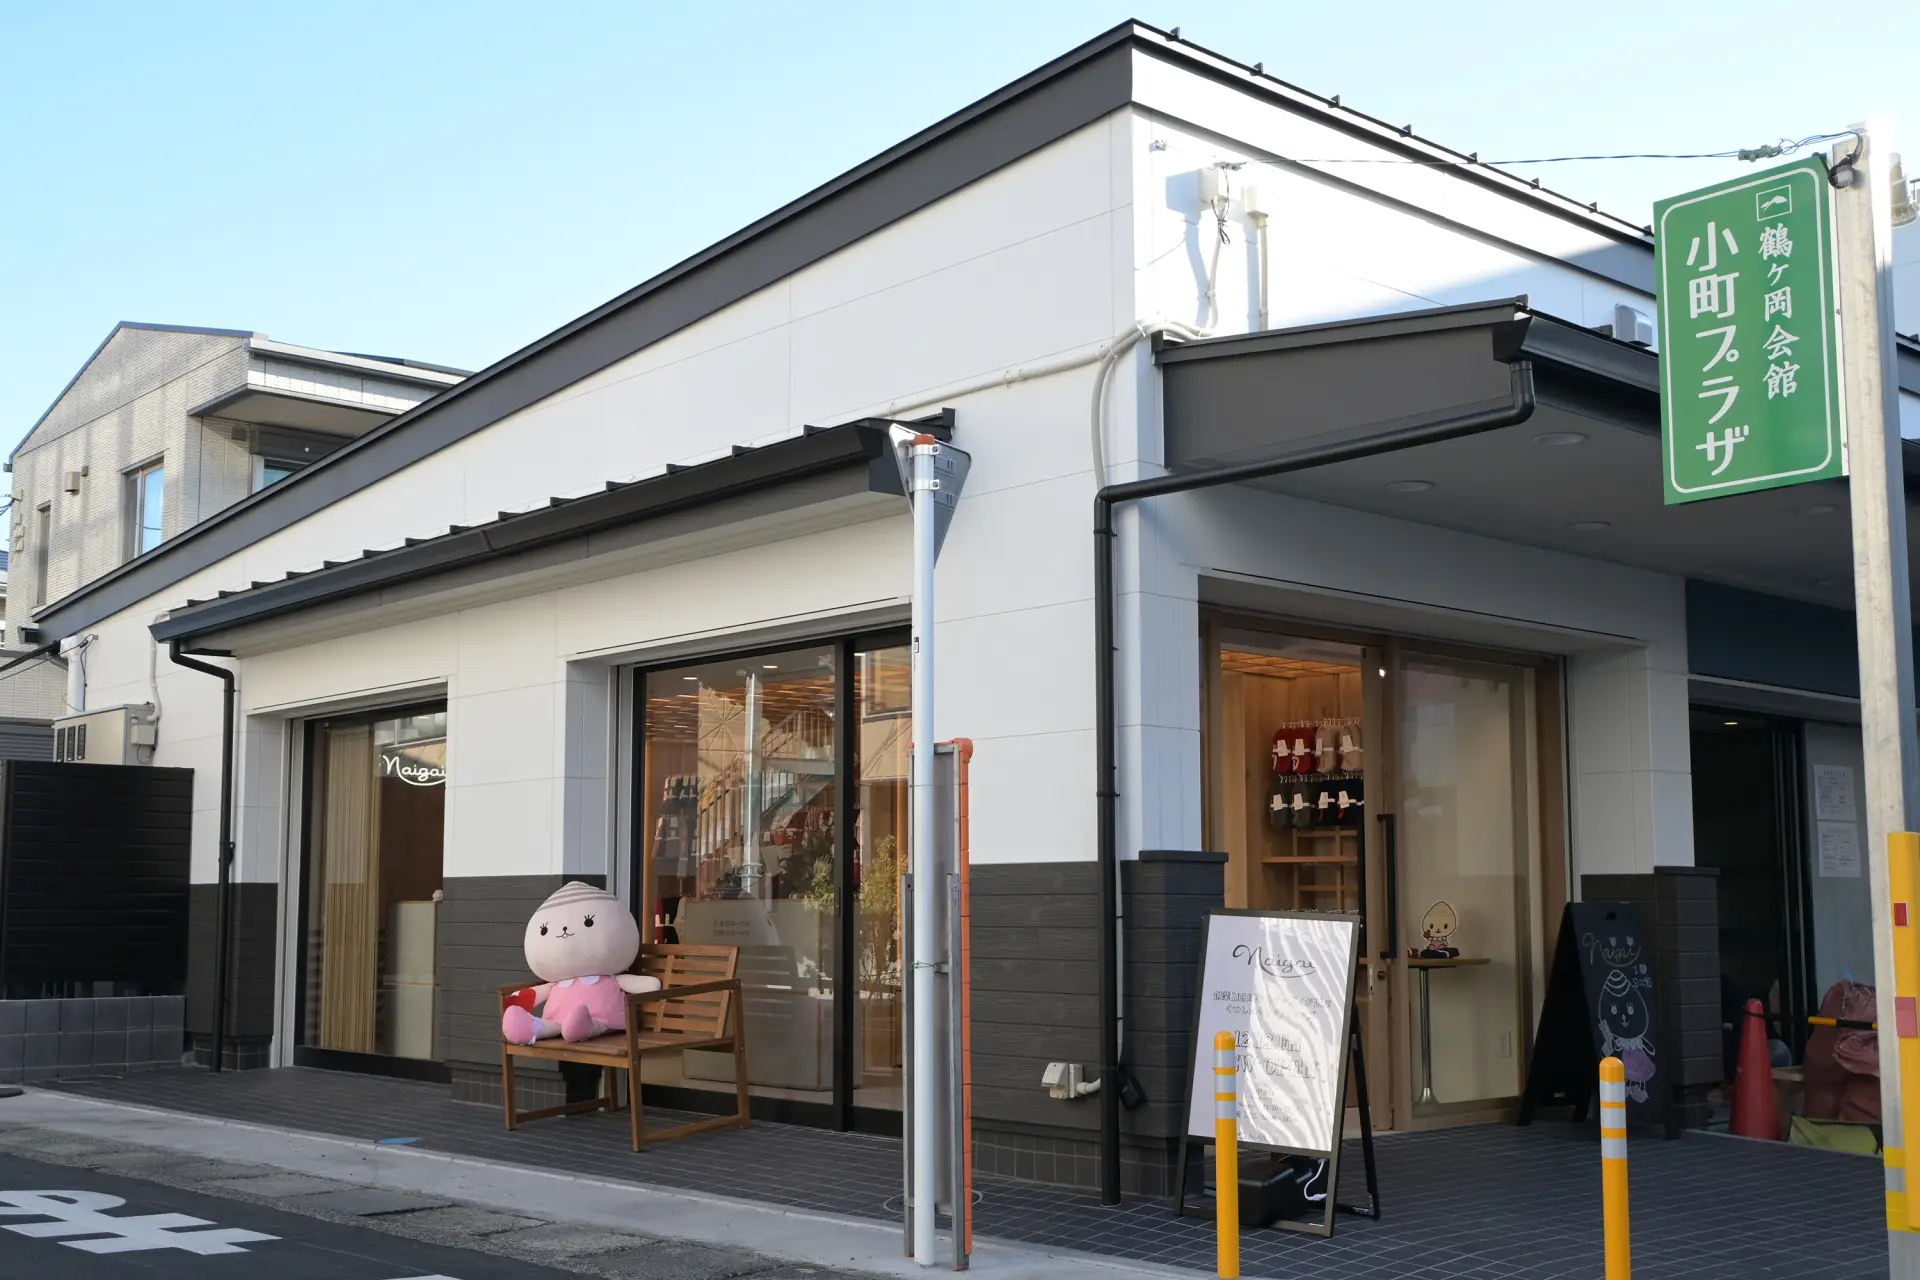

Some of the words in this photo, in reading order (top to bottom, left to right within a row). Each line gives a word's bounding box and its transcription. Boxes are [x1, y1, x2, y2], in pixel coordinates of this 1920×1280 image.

[1686, 221, 1749, 476] 小町プラザ
[379, 754, 446, 786] Naigai
[1232, 944, 1317, 978] Naigai
